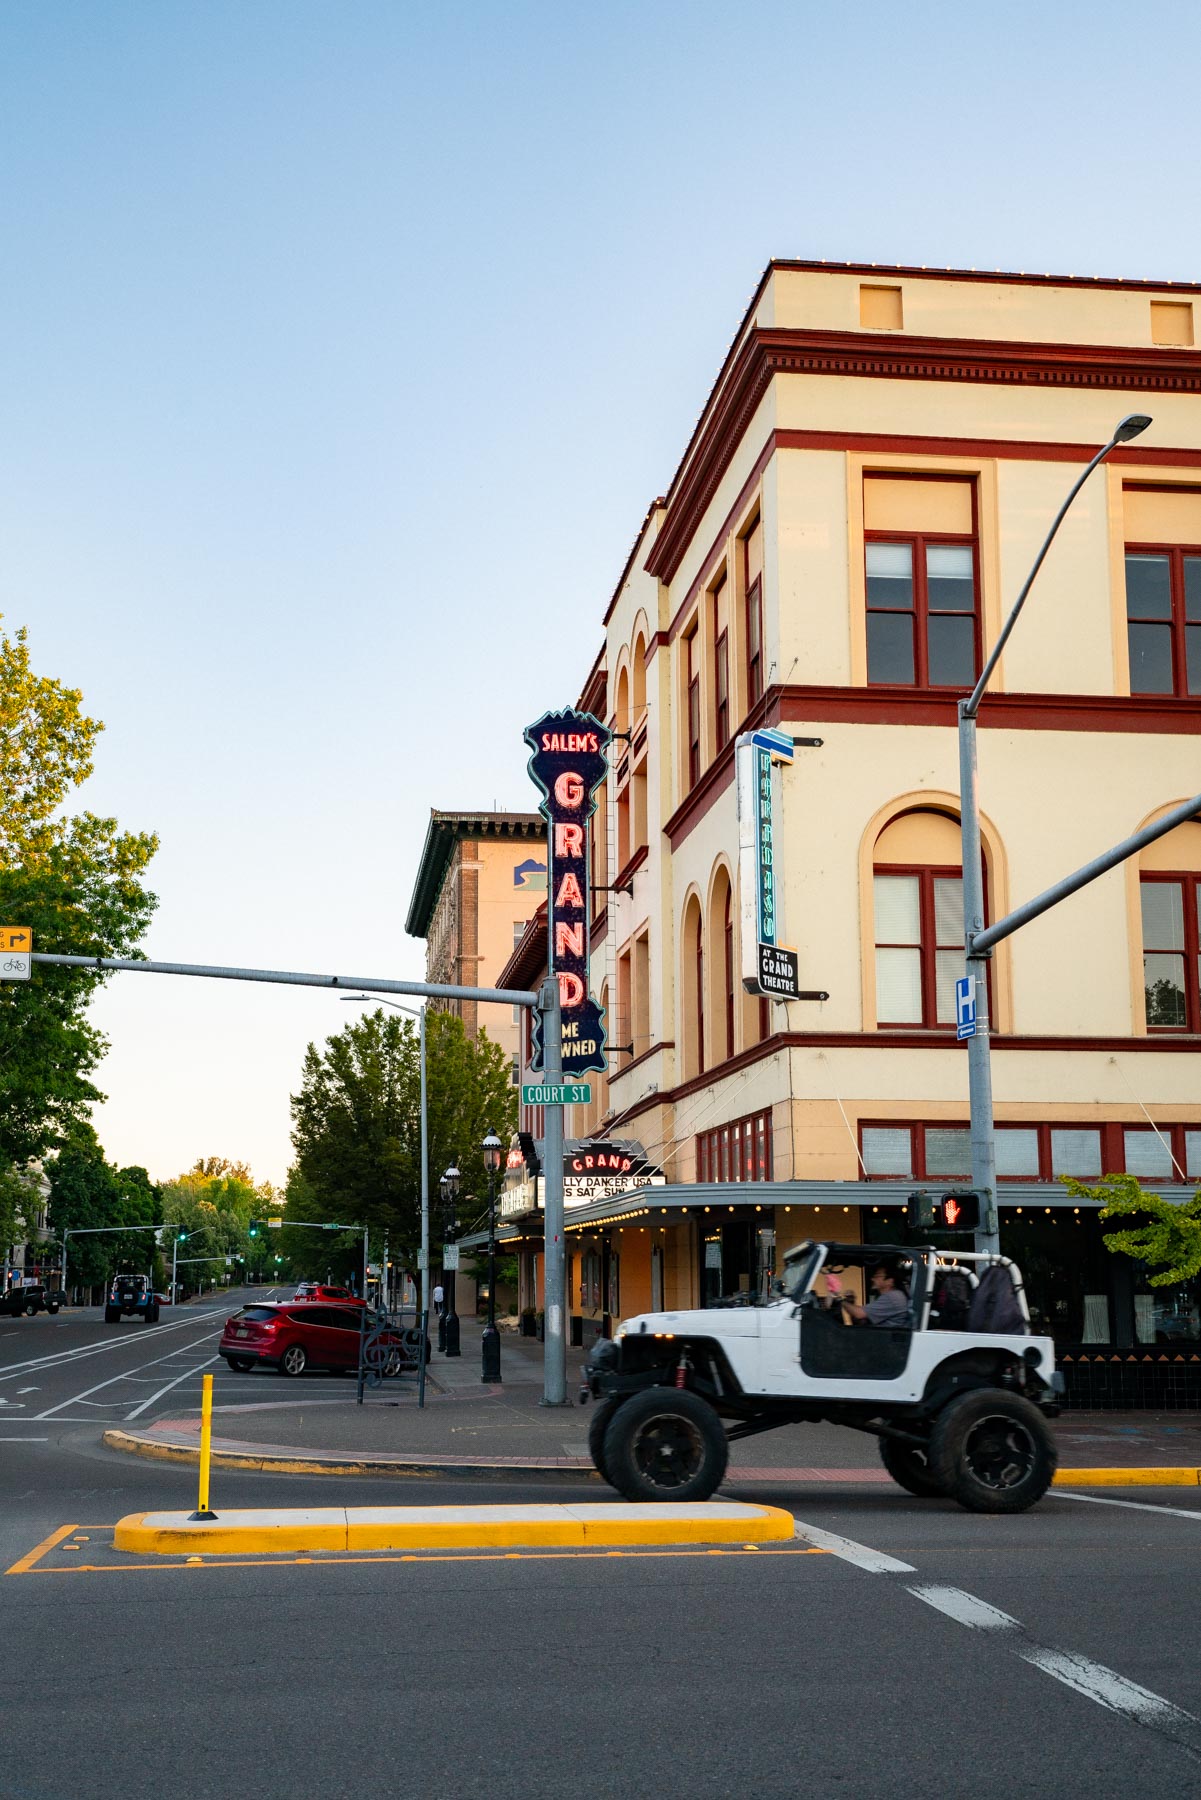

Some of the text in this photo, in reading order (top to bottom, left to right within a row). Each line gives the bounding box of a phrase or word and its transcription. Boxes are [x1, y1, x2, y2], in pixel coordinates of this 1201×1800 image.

[542, 733, 598, 752] SALEM'S
[554, 771, 584, 1008] GRAND
[763, 949, 788, 962] AT THE
[763, 958, 793, 978] GRAND
[763, 974, 795, 992] THEATRE
[957, 975, 976, 1023] H
[561, 1022, 579, 1038] ME
[560, 1040, 596, 1058] WNED
[528, 1086, 585, 1102] COURT ST
[572, 1153, 631, 1171] GRAND
[563, 1177, 652, 1187] LLY DANCER USA
[576, 1187, 596, 1197] SAT
